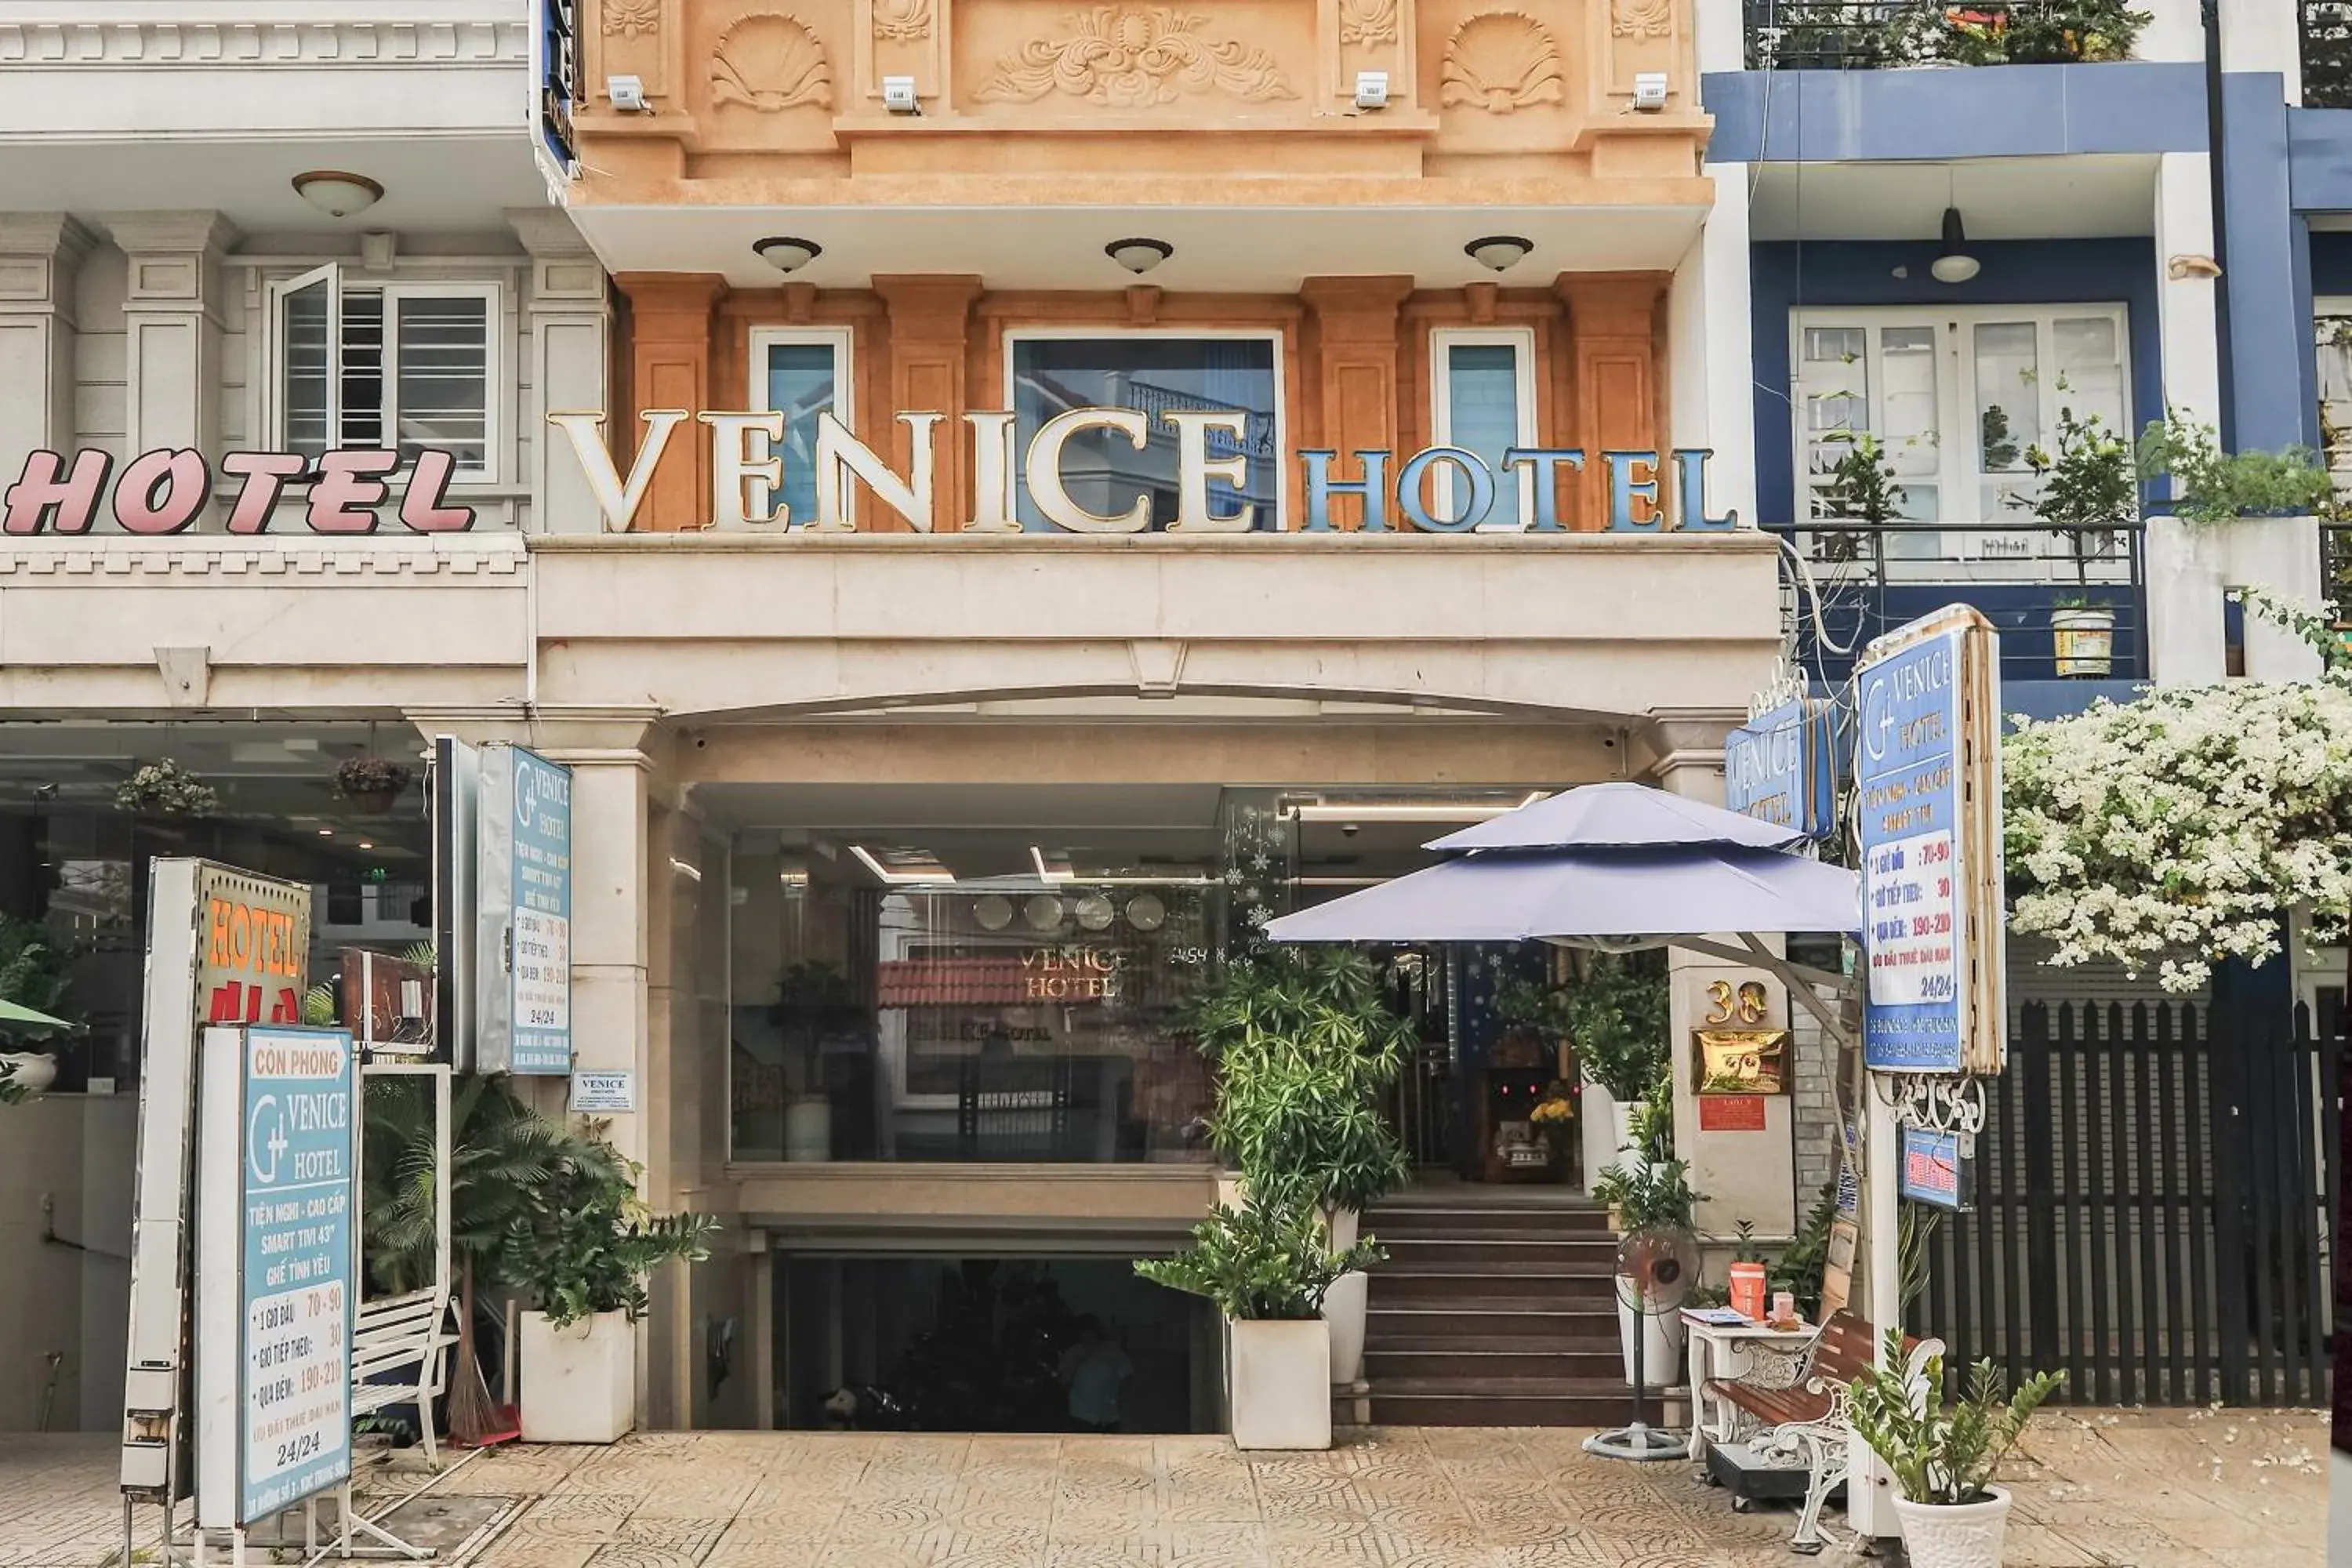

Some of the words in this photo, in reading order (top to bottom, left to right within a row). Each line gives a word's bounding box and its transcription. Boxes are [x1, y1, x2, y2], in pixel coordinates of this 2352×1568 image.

[545, 407, 1254, 534] VENICE
[1298, 445, 1739, 533] HOTEL
[3, 448, 477, 535] HOTEL
[1893, 650, 1951, 703] VENICE
[1899, 710, 1947, 753] HOTEL
[1728, 716, 1798, 791] VENICE
[535, 766, 568, 808] VENICE
[1937, 877, 1950, 898] 30
[209, 897, 299, 978] HOTEL
[1021, 945, 1128, 972] VENICE
[1025, 977, 1117, 998] HOTEL
[1706, 980, 1769, 1024] 38
[1921, 974, 1951, 1000] 24/24
[254, 1042, 287, 1076] CÒN
[290, 1043, 339, 1076] PHÒNG
[583, 1079, 626, 1089] VENICE
[285, 1092, 347, 1132] VENICE
[294, 1149, 341, 1180] HOTEL
[249, 1200, 274, 1229] TIỆN
[275, 1202, 299, 1223] NGHI
[307, 1198, 326, 1218] CAO
[327, 1189, 346, 1215] CẤP
[261, 1231, 296, 1255] SMART
[298, 1227, 316, 1249] TIVI
[266, 1257, 286, 1287] GHẾ
[288, 1257, 310, 1282] TÌNH
[312, 1252, 330, 1276] YÊU
[329, 1323, 341, 1348] 30
[260, 1384, 274, 1410] QUA
[300, 1359, 341, 1393] 190-210
[277, 1431, 321, 1467] 24/24
